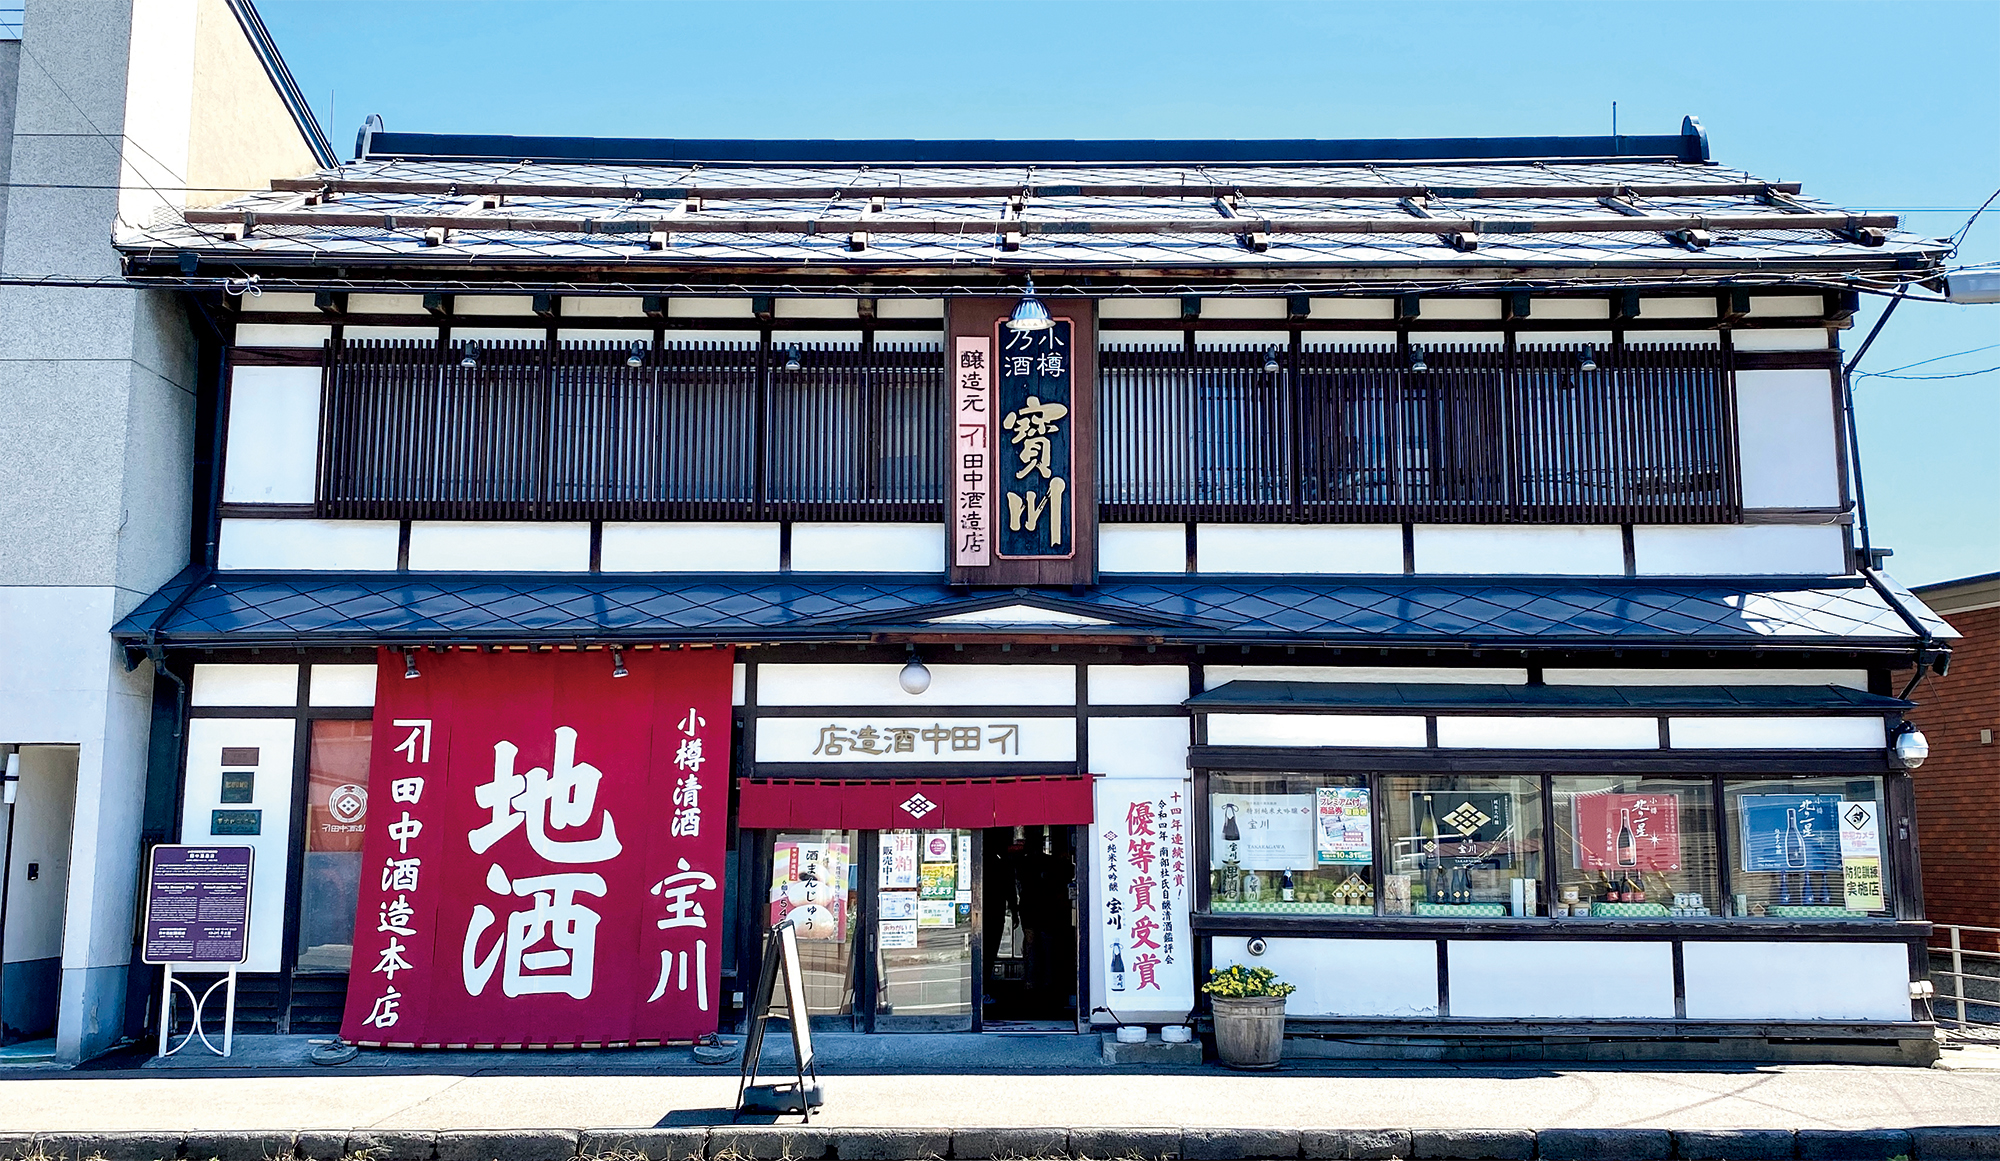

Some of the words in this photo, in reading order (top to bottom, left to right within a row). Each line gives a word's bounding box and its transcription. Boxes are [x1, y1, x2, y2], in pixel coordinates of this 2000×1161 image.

[960, 454, 986, 553] 田中酒造店
[669, 707, 706, 838] 小樽清酒
[1157, 799, 1168, 841] 令和四年
[1320, 798, 1360, 806] プレミアム付
[1247, 818, 1270, 830] 宝川
[462, 726, 623, 1000] 地酒
[894, 835, 914, 872] 酒粕
[1106, 843, 1119, 892] 純米大吟醸
[1228, 842, 1238, 860] 宝川
[1457, 844, 1478, 854] 宝川
[804, 850, 819, 930] 酒まんじゅう
[922, 887, 954, 896] 使えます
[1845, 865, 1878, 879] 防犯訓練
[1846, 881, 1880, 896] 実施店
[362, 777, 425, 1029] 田中酒造本店
[1106, 897, 1123, 930] 宝川
[1125, 801, 1161, 991] 優等賞受賞
[646, 857, 717, 1012] 宝川
